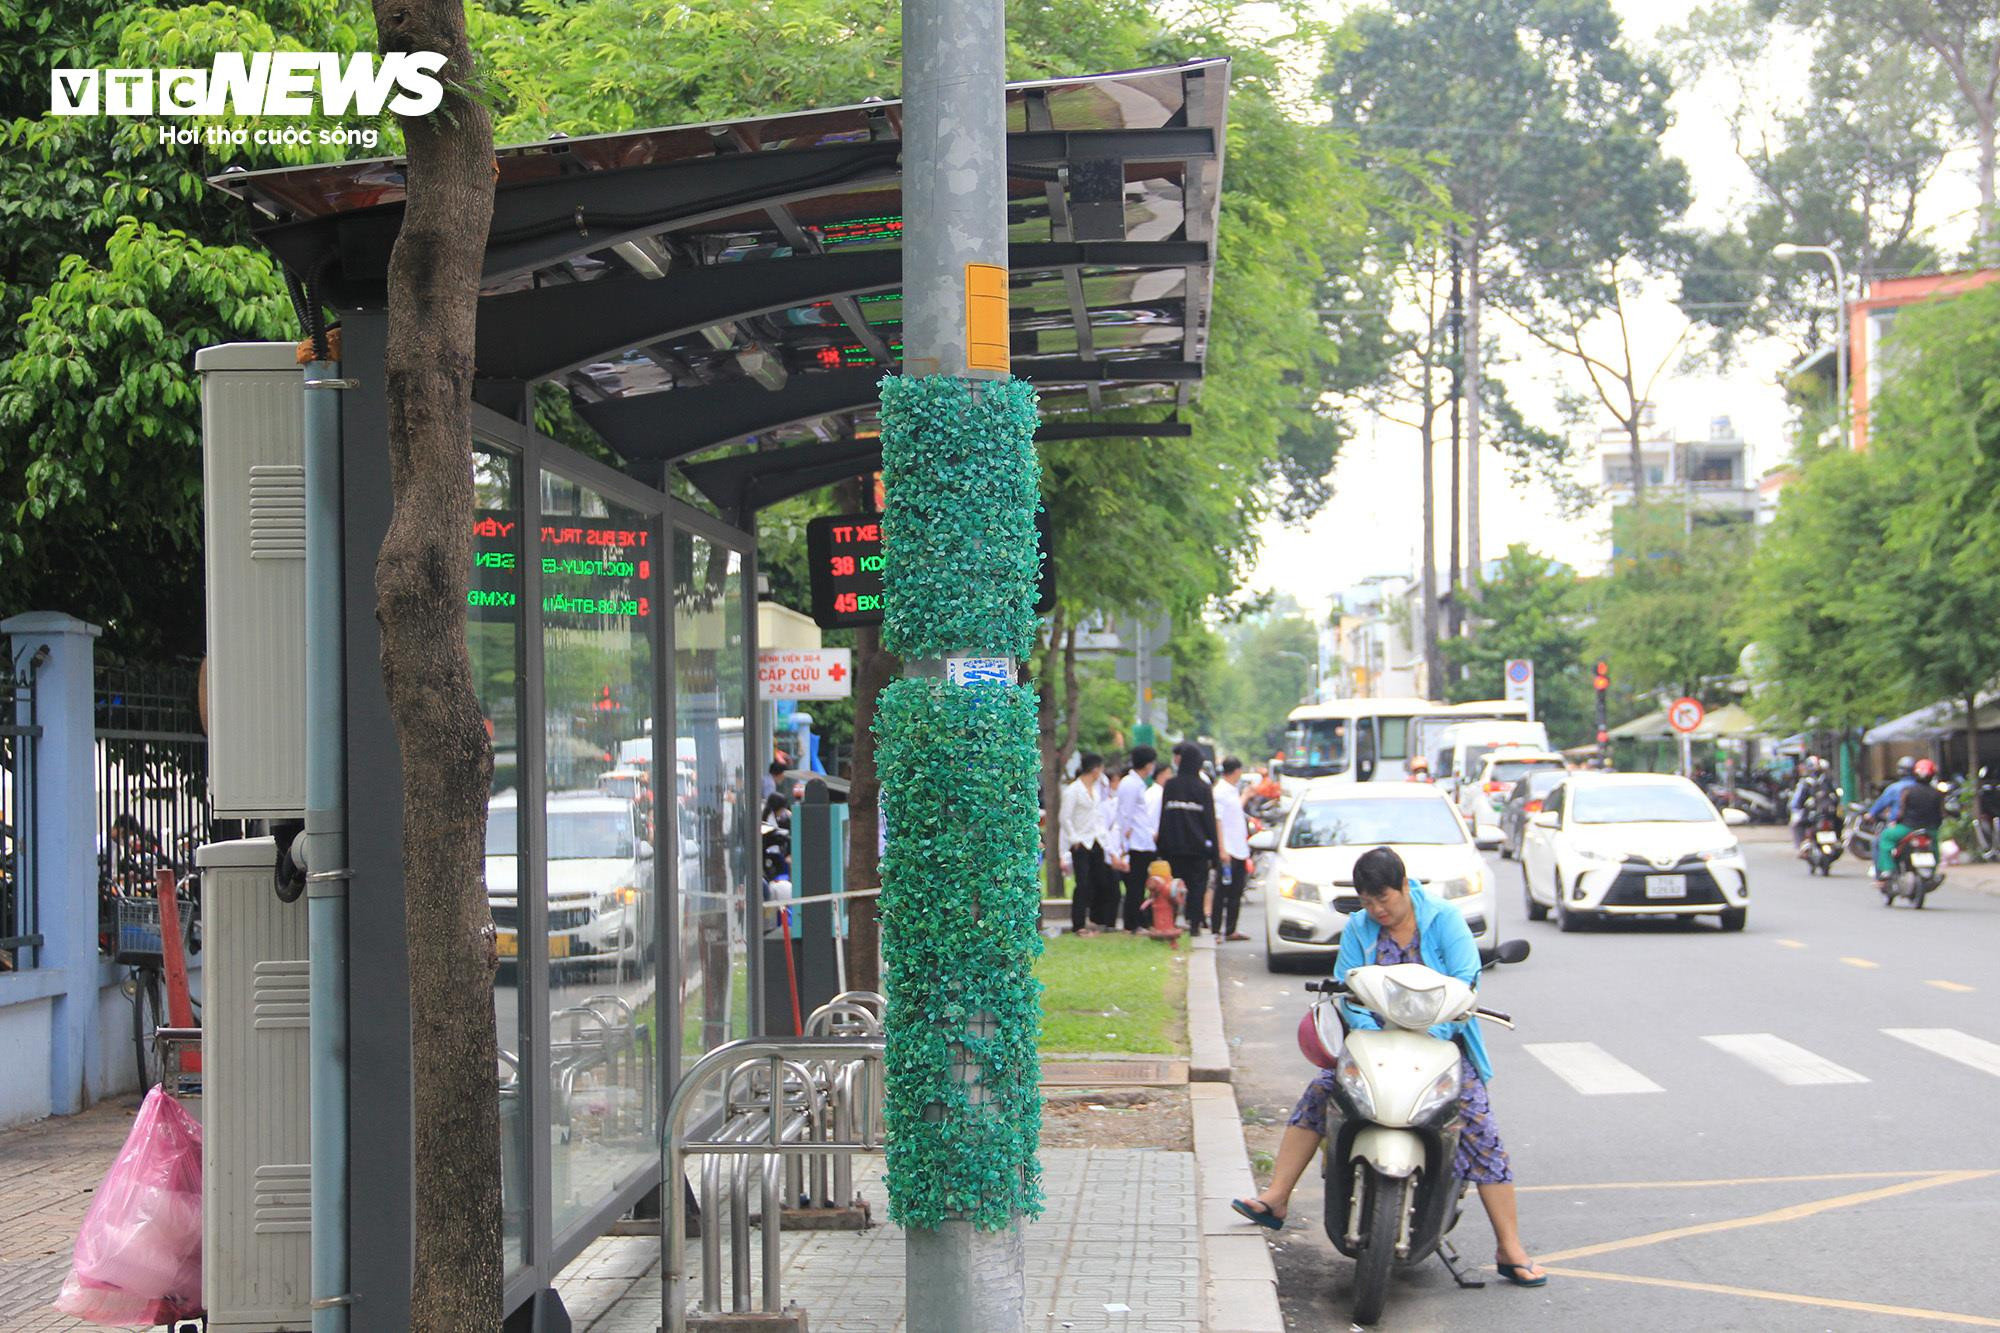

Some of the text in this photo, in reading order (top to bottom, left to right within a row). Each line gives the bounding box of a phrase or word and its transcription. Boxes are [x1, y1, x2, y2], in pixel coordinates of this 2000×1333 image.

[832, 526, 854, 544] TT
[855, 524, 879, 543] XE
[830, 555, 855, 577] 38
[834, 592, 887, 614] 45 BX.
